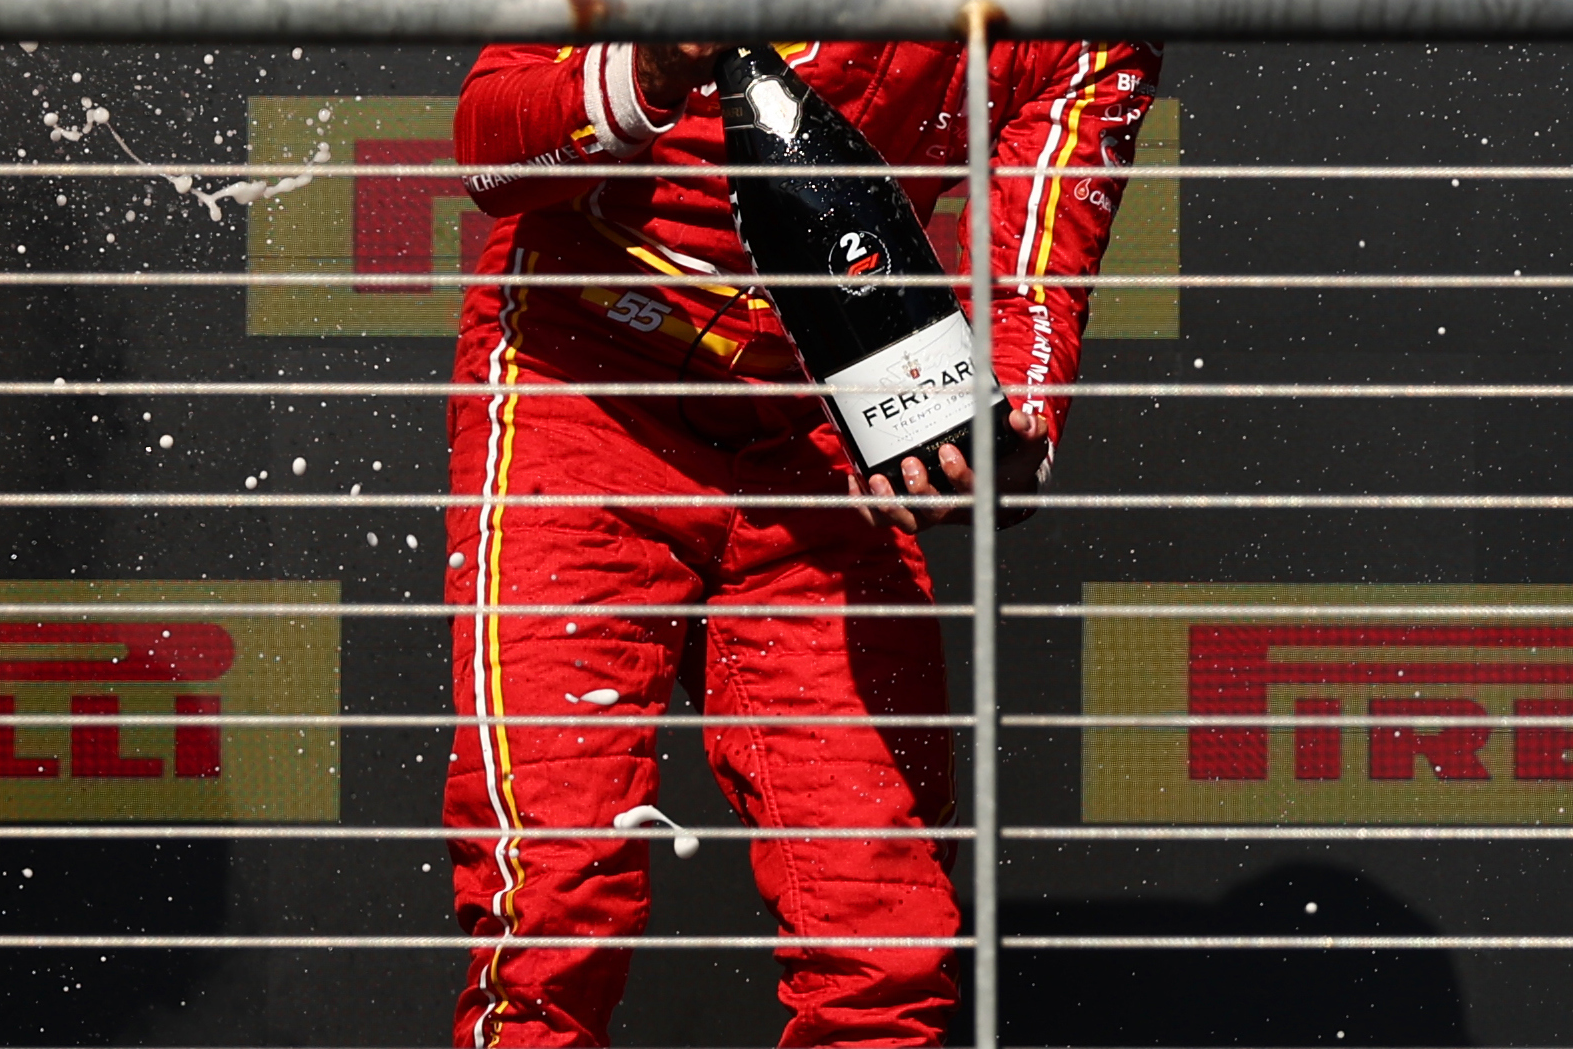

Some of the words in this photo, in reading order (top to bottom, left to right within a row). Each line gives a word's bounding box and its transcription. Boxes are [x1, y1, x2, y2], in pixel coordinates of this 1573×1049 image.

[607, 291, 673, 332] 55
[862, 357, 976, 428] FERRAR
[892, 403, 942, 431] TRENTO
[1188, 625, 1573, 781] PIRE
